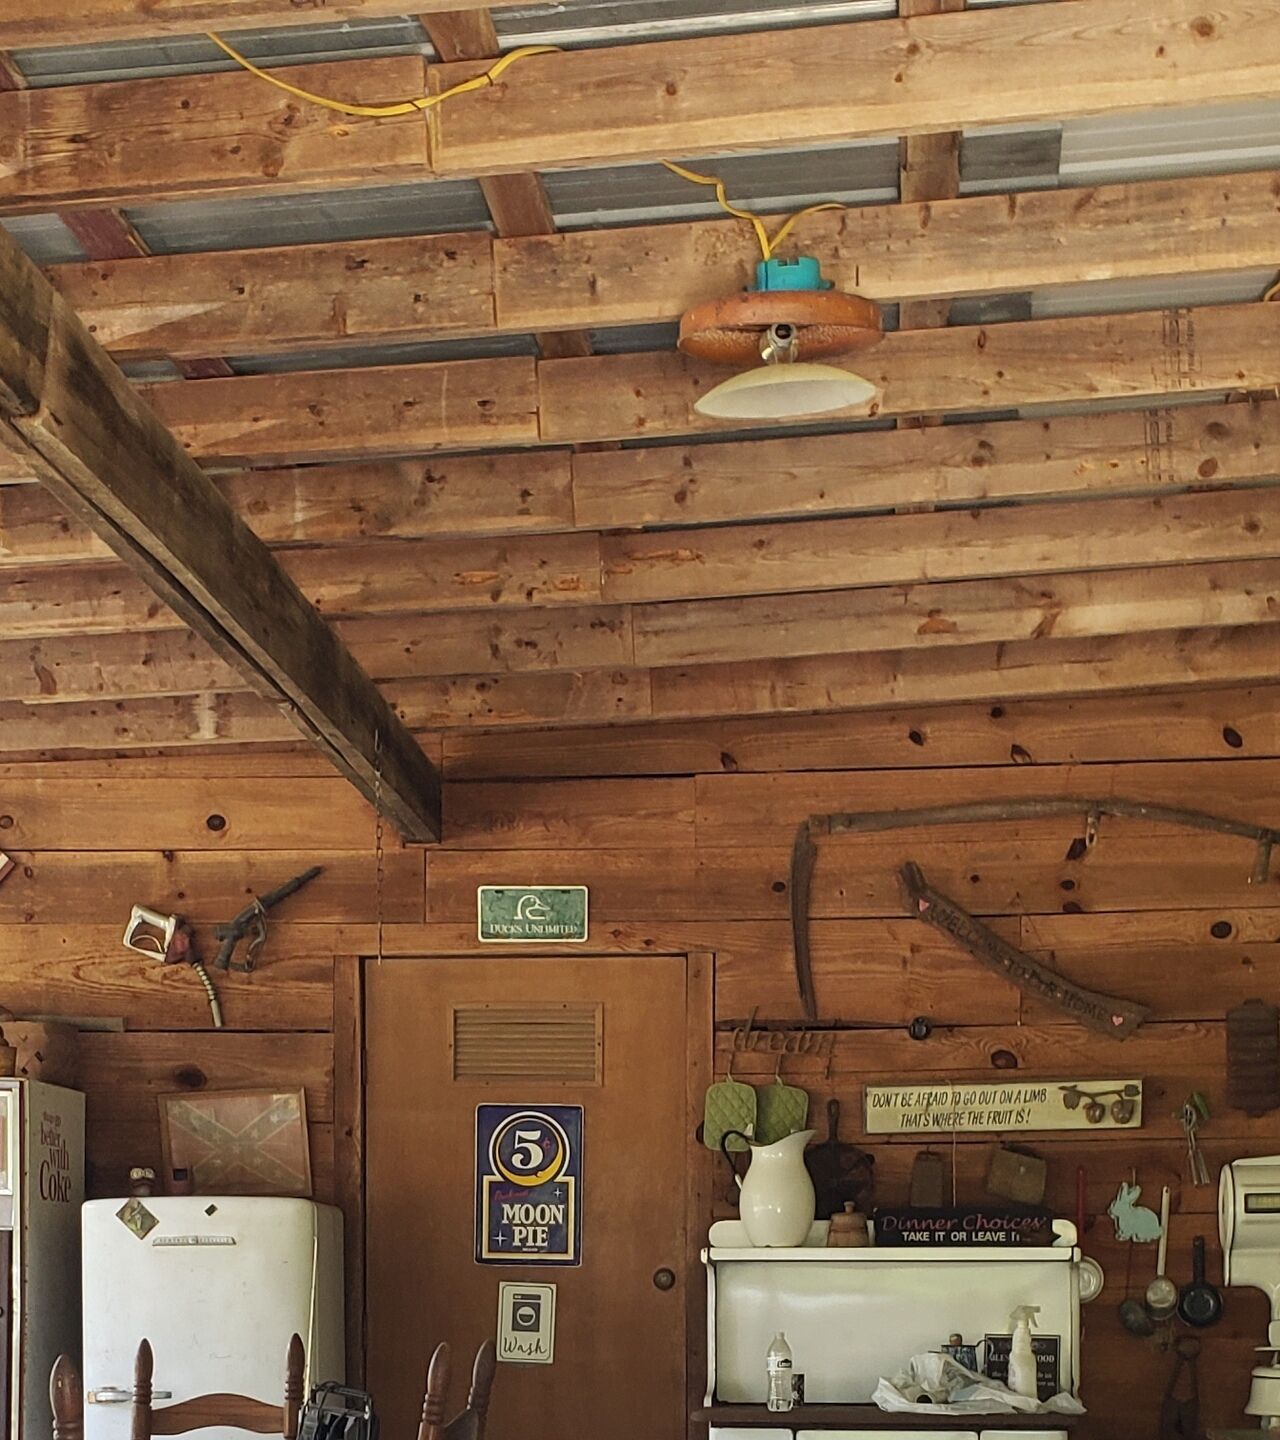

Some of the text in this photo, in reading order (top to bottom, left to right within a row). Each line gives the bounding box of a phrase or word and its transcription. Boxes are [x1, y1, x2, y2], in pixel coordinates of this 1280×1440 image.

[490, 924, 578, 934] DUCKS UNLIMITED
[900, 1092, 914, 1108] BE
[914, 1090, 948, 1108] AFRAID
[950, 1090, 961, 1107] TO
[962, 1089, 977, 1105] GO
[978, 1088, 997, 1104] OUT
[999, 1088, 1012, 1104] ON
[1013, 1088, 1023, 1104] A
[1023, 1087, 1047, 1103] LIMB
[931, 1110, 966, 1128] WHERE
[967, 1109, 985, 1126] THE
[986, 1108, 1014, 1125] FRUIT
[40, 1160, 71, 1203] Coke
[501, 1203, 565, 1225] MOON
[881, 1213, 1047, 1232] Dinner Choices
[512, 1226, 549, 1247] PIE
[902, 1231, 930, 1242] TAKE
[935, 1231, 946, 1242] IT
[950, 1231, 967, 1242] OR
[972, 1231, 1007, 1242] LEAVE
[504, 1335, 547, 1356] Wash
